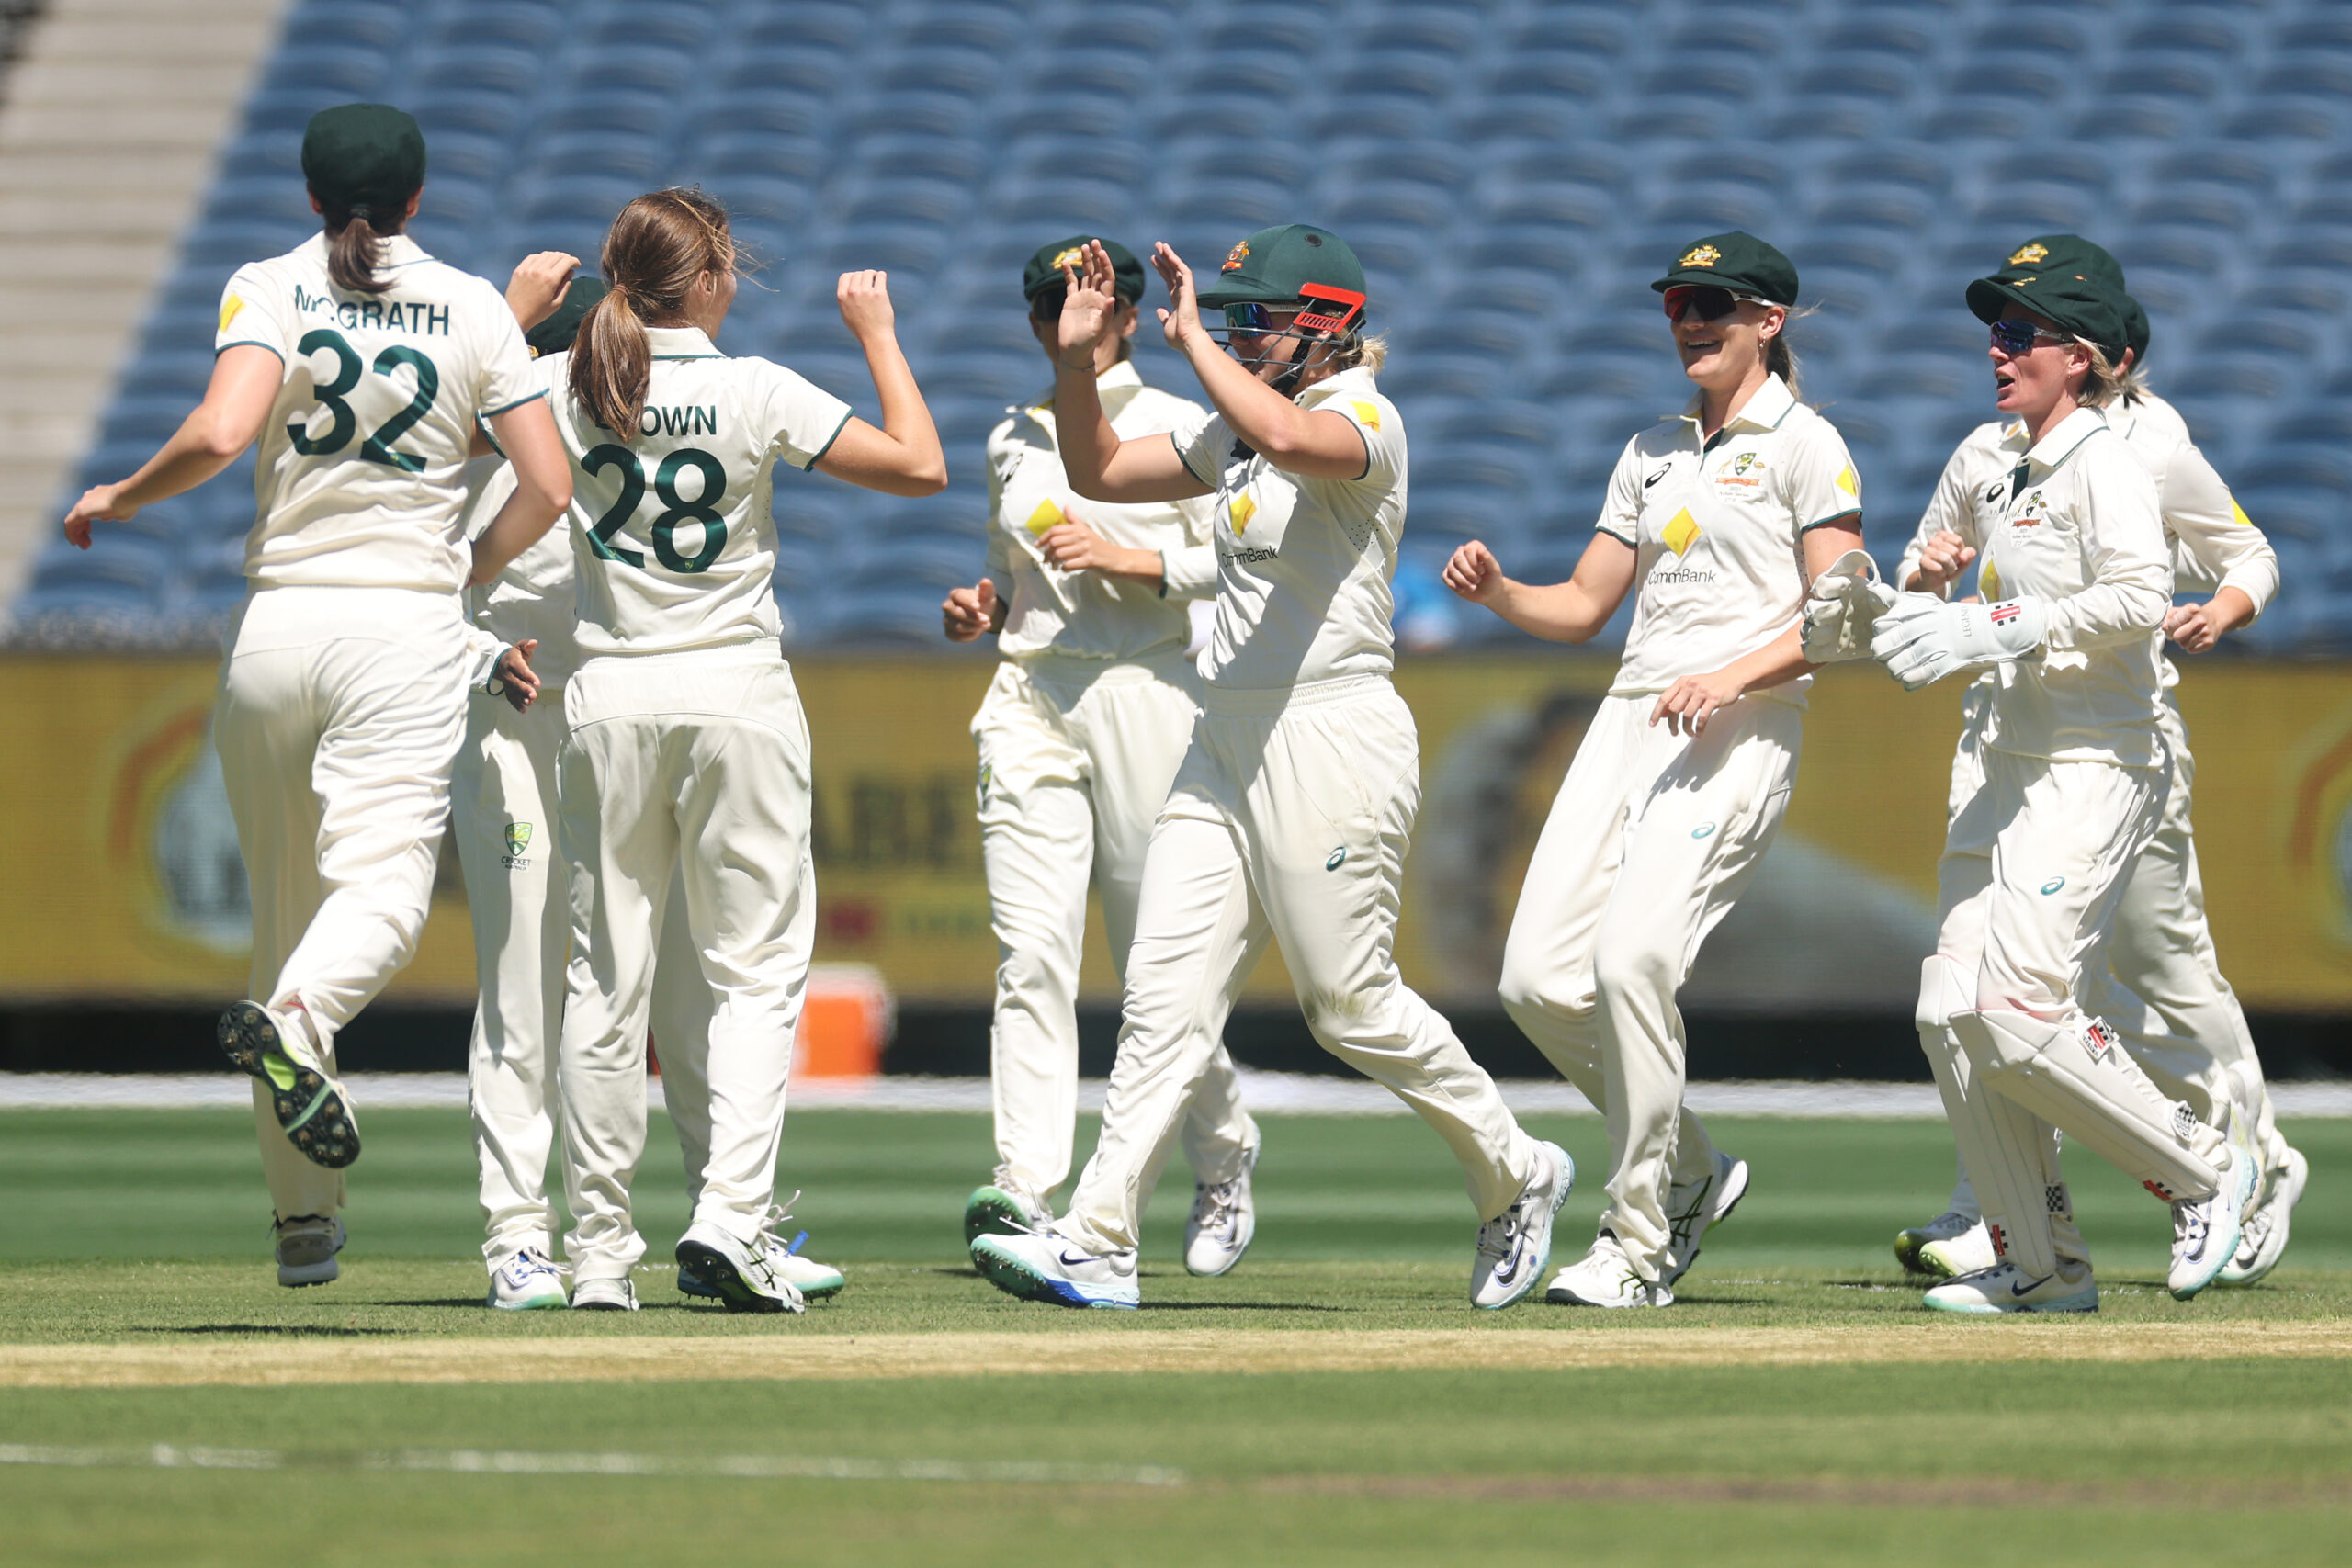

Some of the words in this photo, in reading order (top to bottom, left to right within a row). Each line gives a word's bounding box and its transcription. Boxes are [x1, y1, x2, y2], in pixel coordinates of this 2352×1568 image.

[287, 327, 438, 473] 32
[595, 404, 718, 437] OWN
[580, 443, 728, 574] 28
[501, 855, 532, 866] CRICKET
